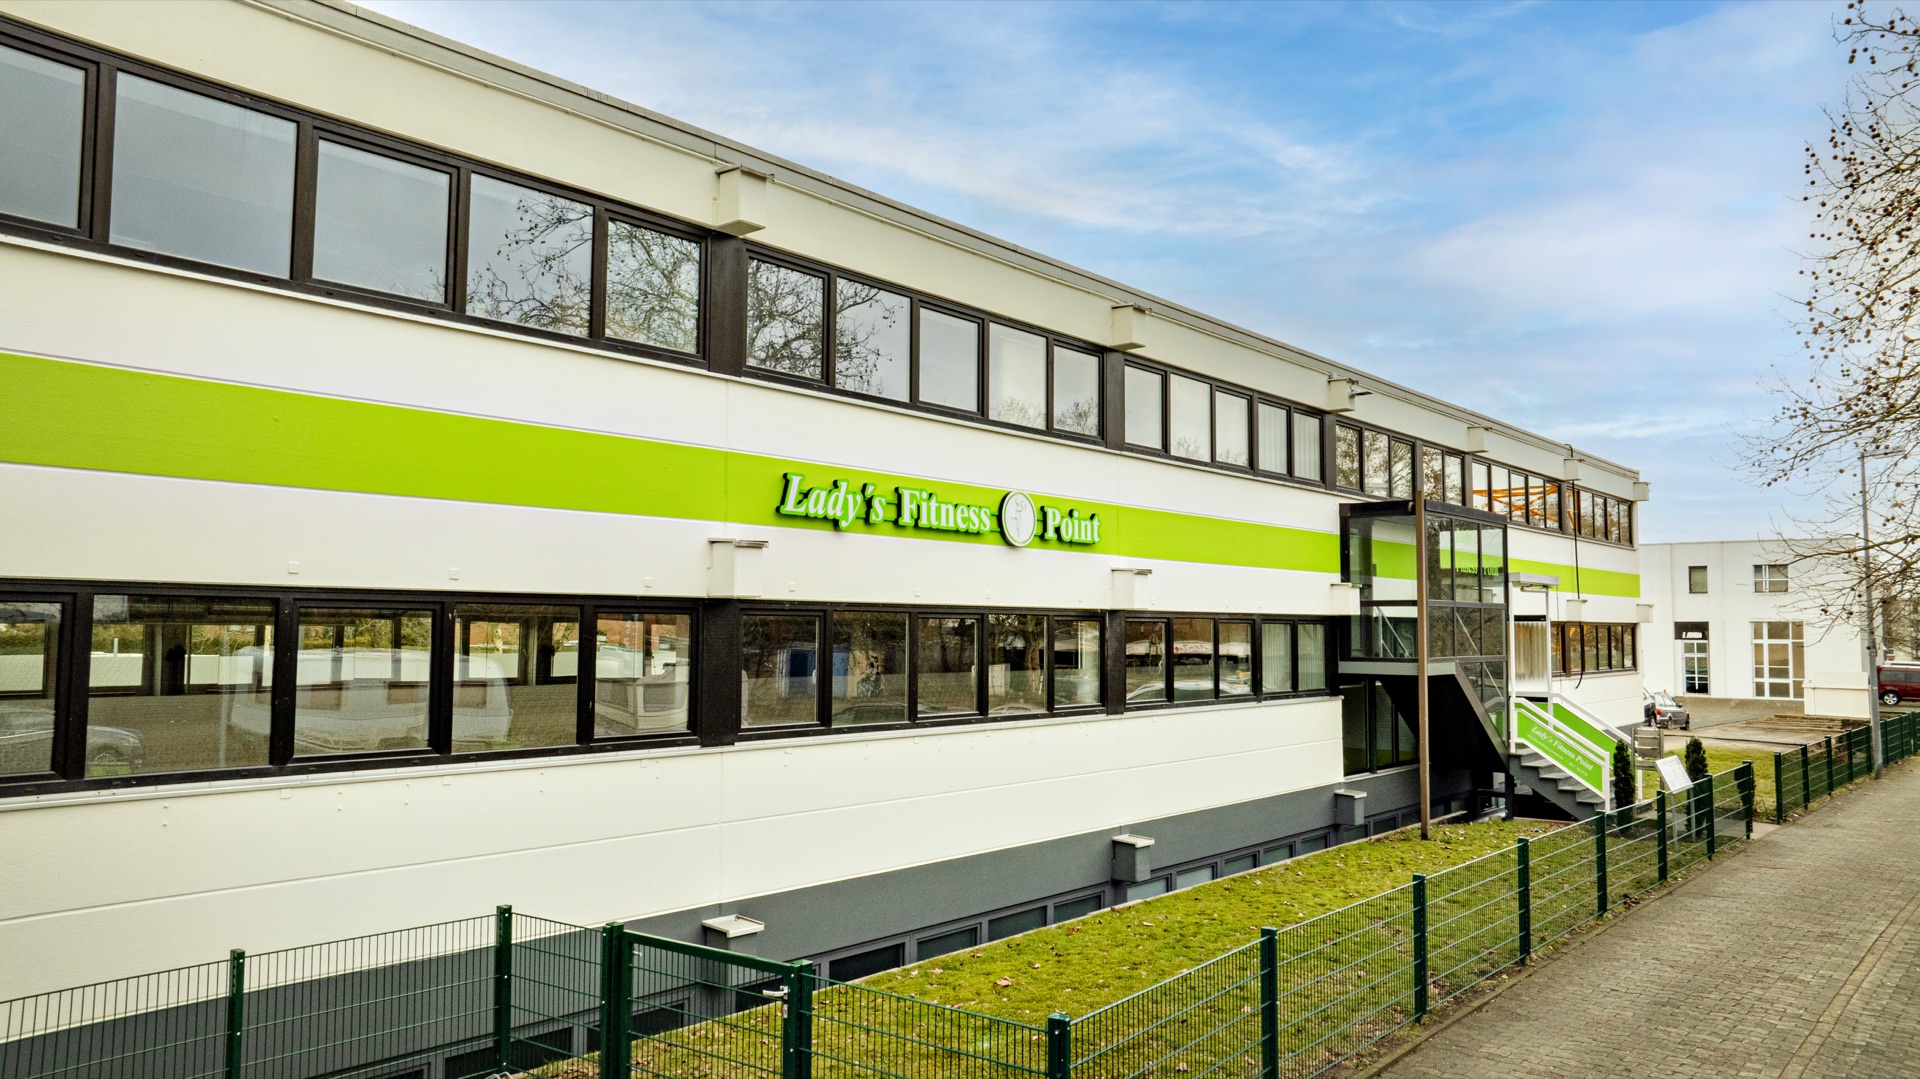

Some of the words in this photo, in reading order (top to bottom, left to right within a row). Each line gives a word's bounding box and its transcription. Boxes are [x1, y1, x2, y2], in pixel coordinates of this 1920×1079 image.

[898, 487, 992, 532] Fitness
[1045, 505, 1101, 543] Point
[1553, 740, 1576, 759] Fitness
[1575, 755, 1594, 771] Point
